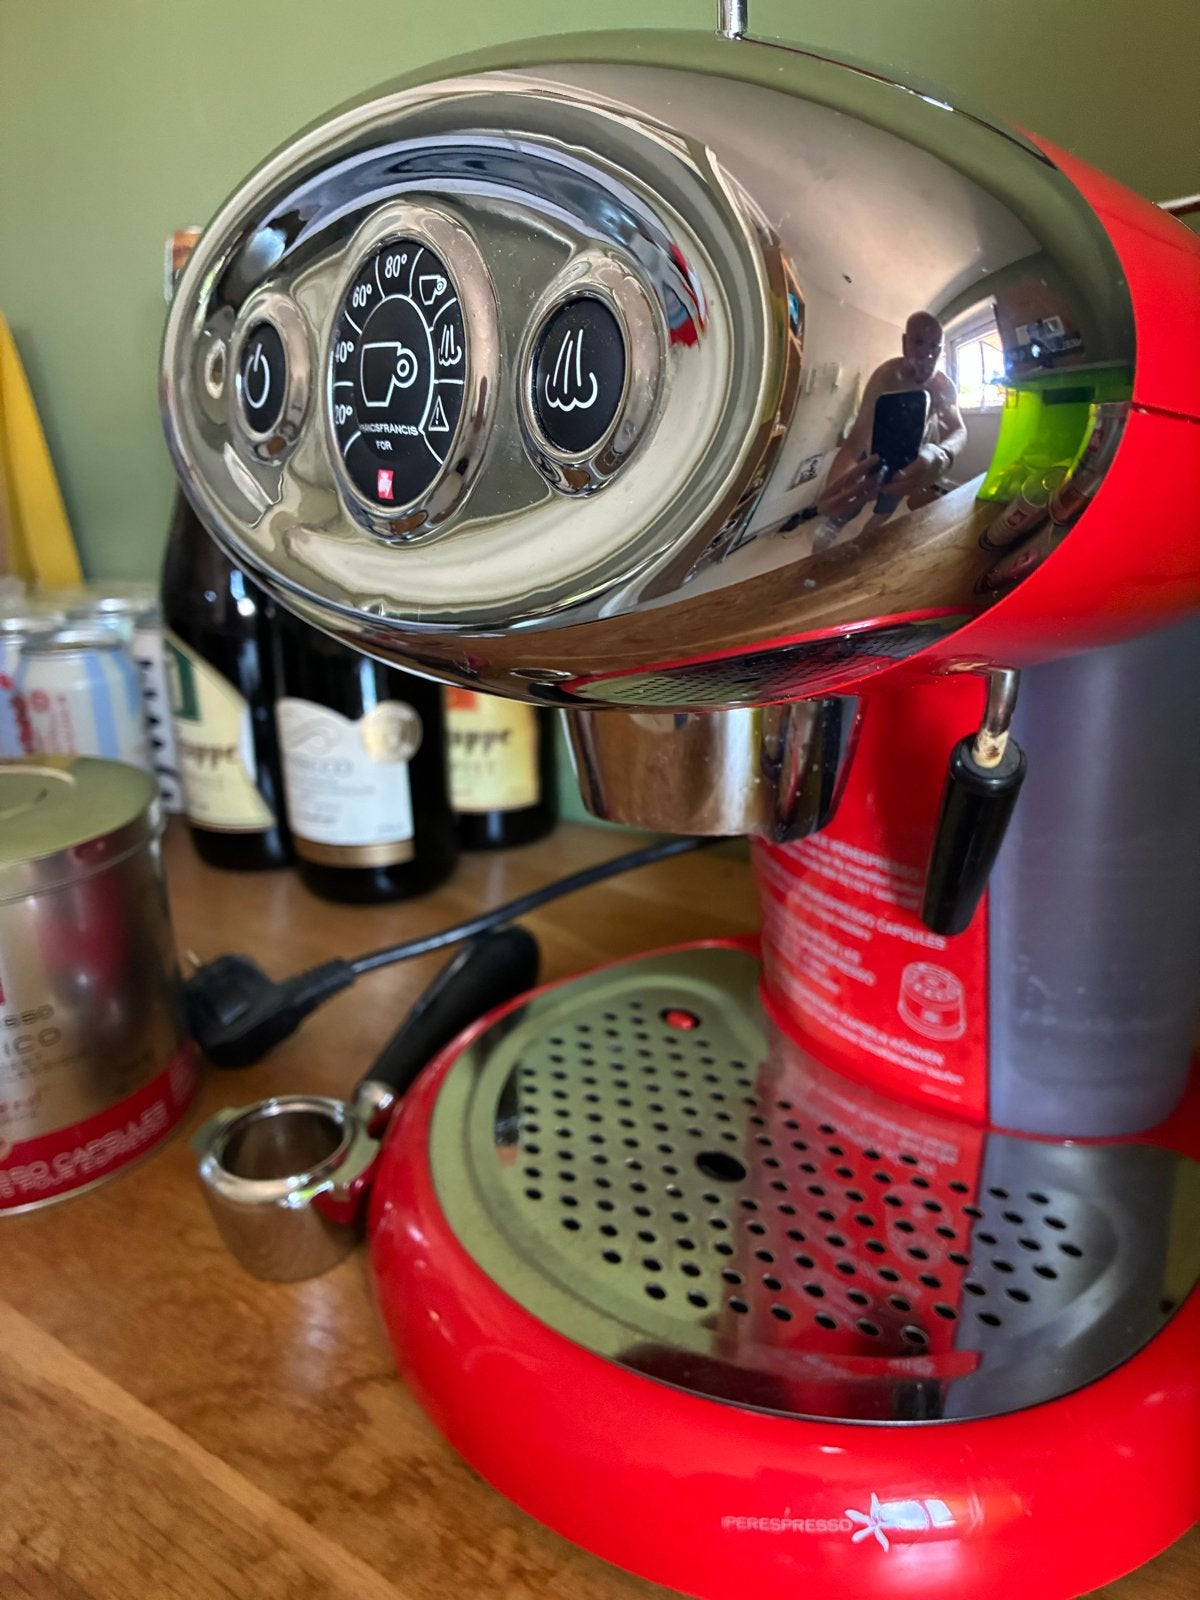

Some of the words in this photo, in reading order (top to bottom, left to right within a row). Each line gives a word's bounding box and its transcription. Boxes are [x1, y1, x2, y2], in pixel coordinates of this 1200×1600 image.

[385, 254, 407, 278] 80°
[352, 283, 372, 308] 60°
[375, 440, 393, 451] FOR
